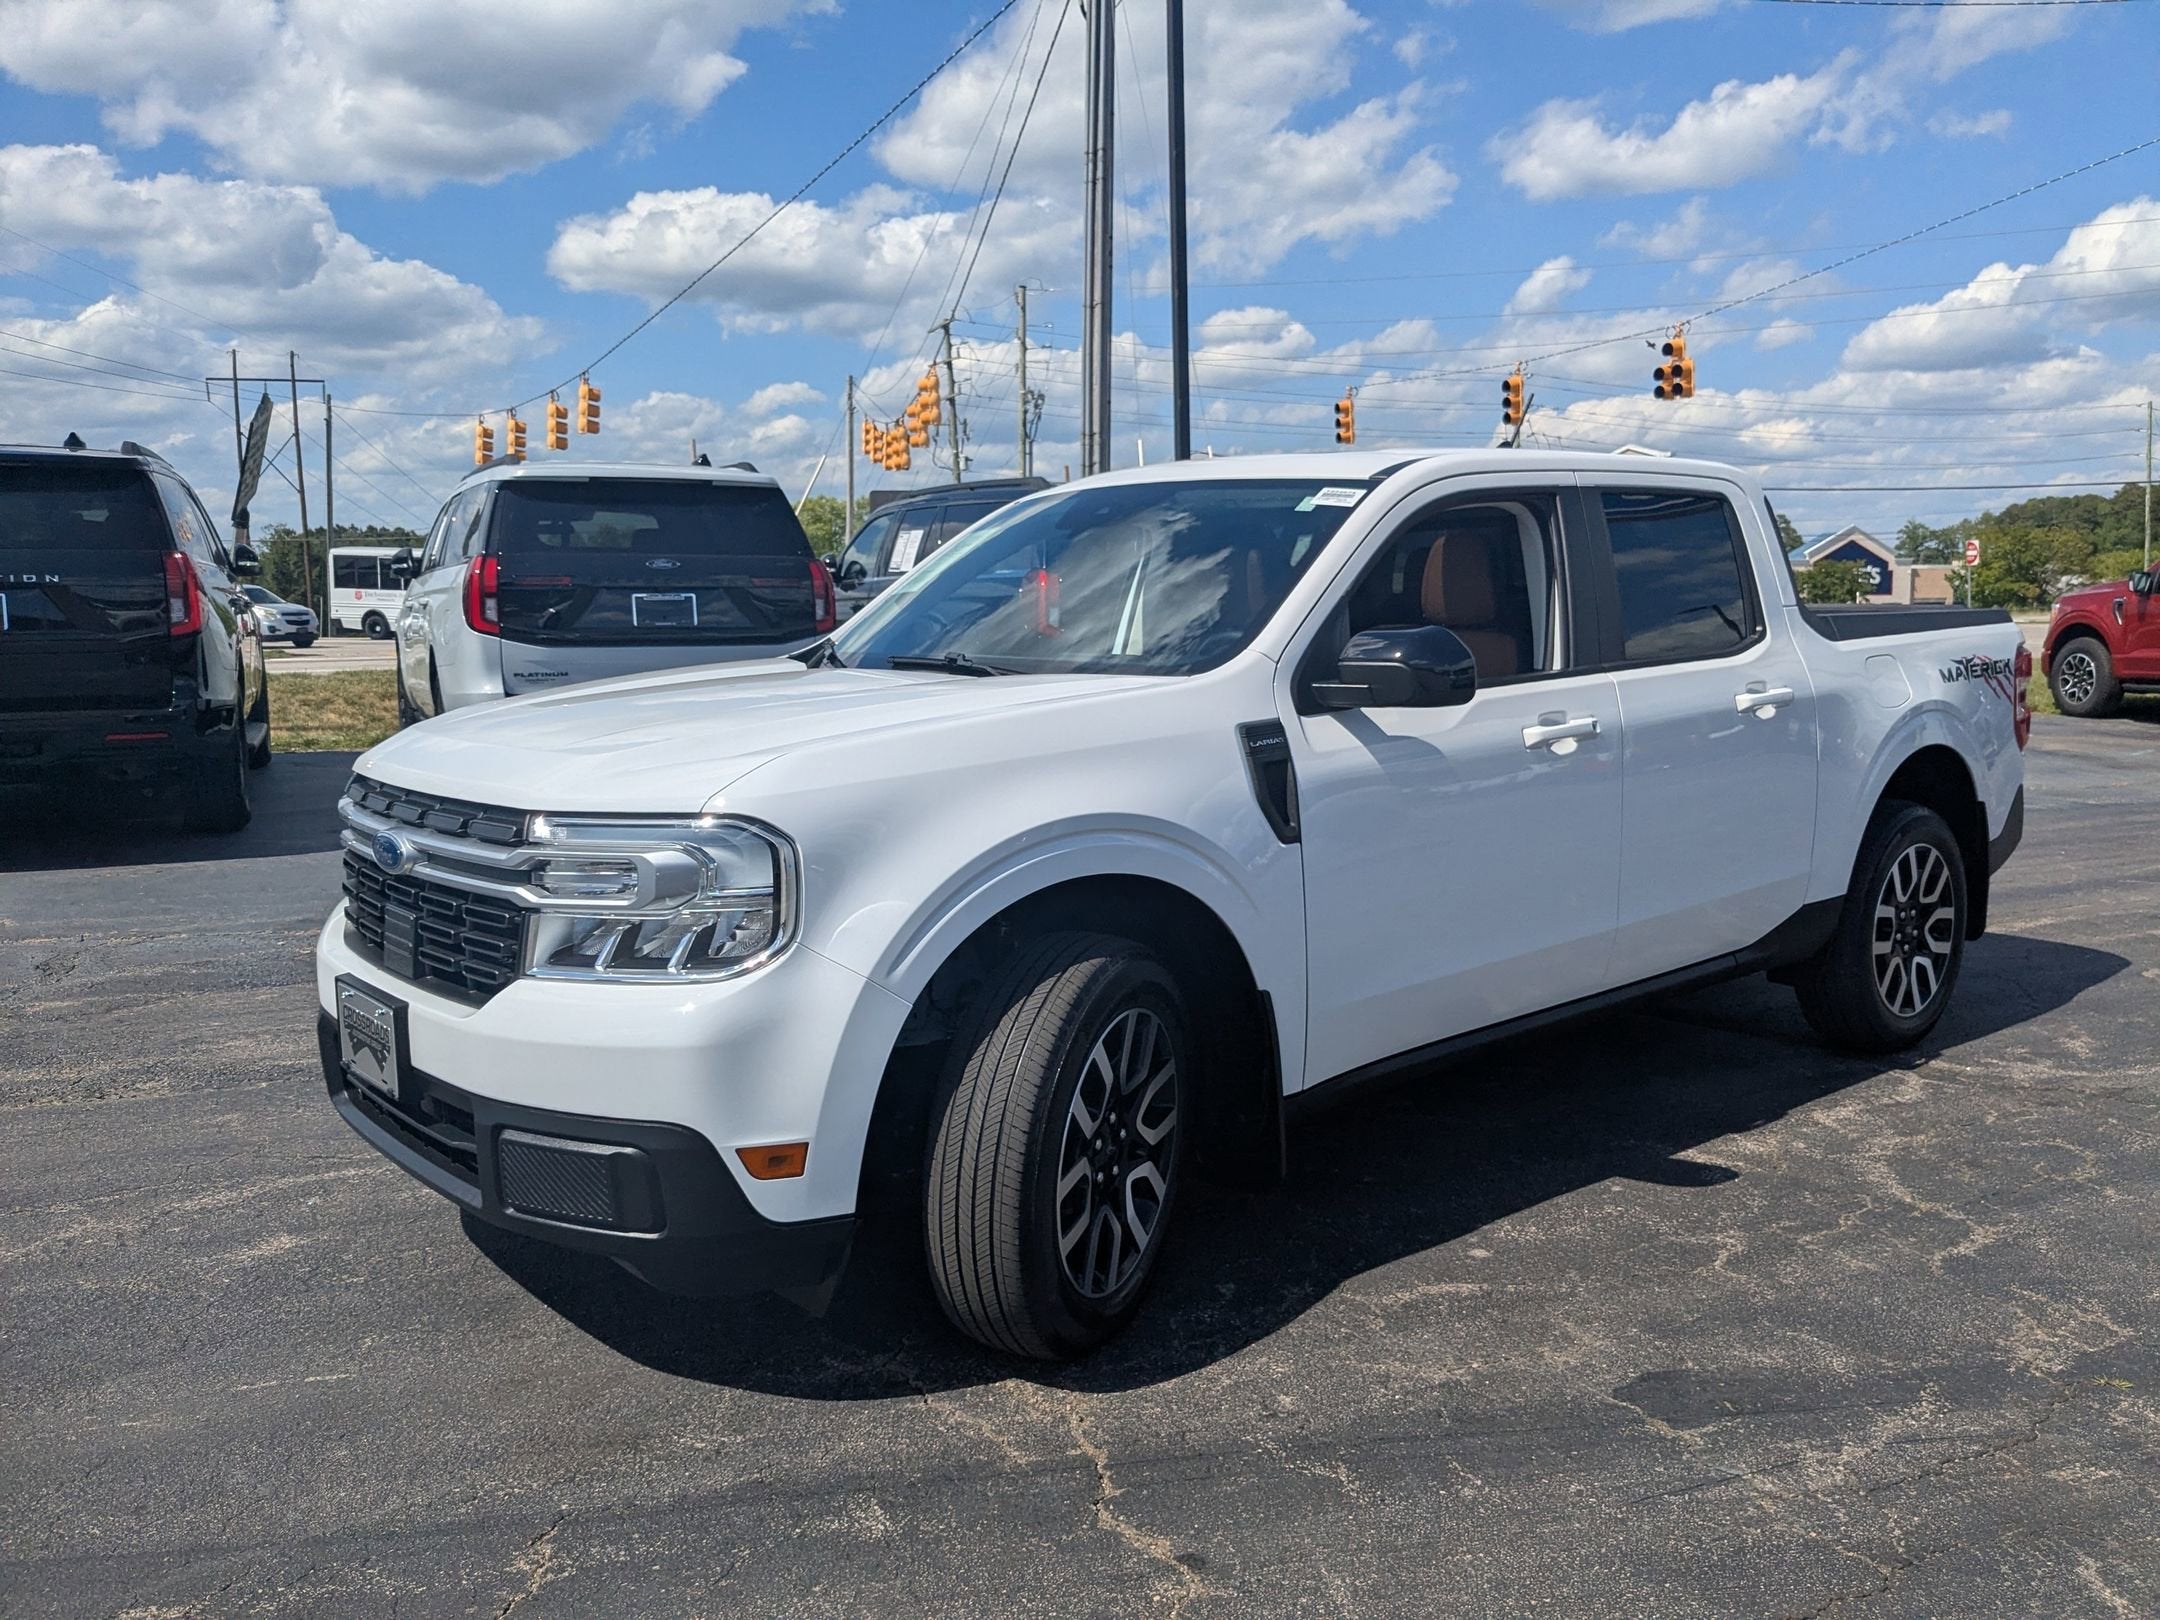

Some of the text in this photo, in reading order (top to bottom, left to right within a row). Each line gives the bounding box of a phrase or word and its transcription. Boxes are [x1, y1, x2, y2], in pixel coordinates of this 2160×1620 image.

[0, 574, 60, 583] ION
[513, 671, 569, 679] PLATINUM
[1939, 655, 2014, 684] MAVERICK
[1249, 736, 1285, 748] LARIAT
[343, 1003, 391, 1044] CROSSROADS
